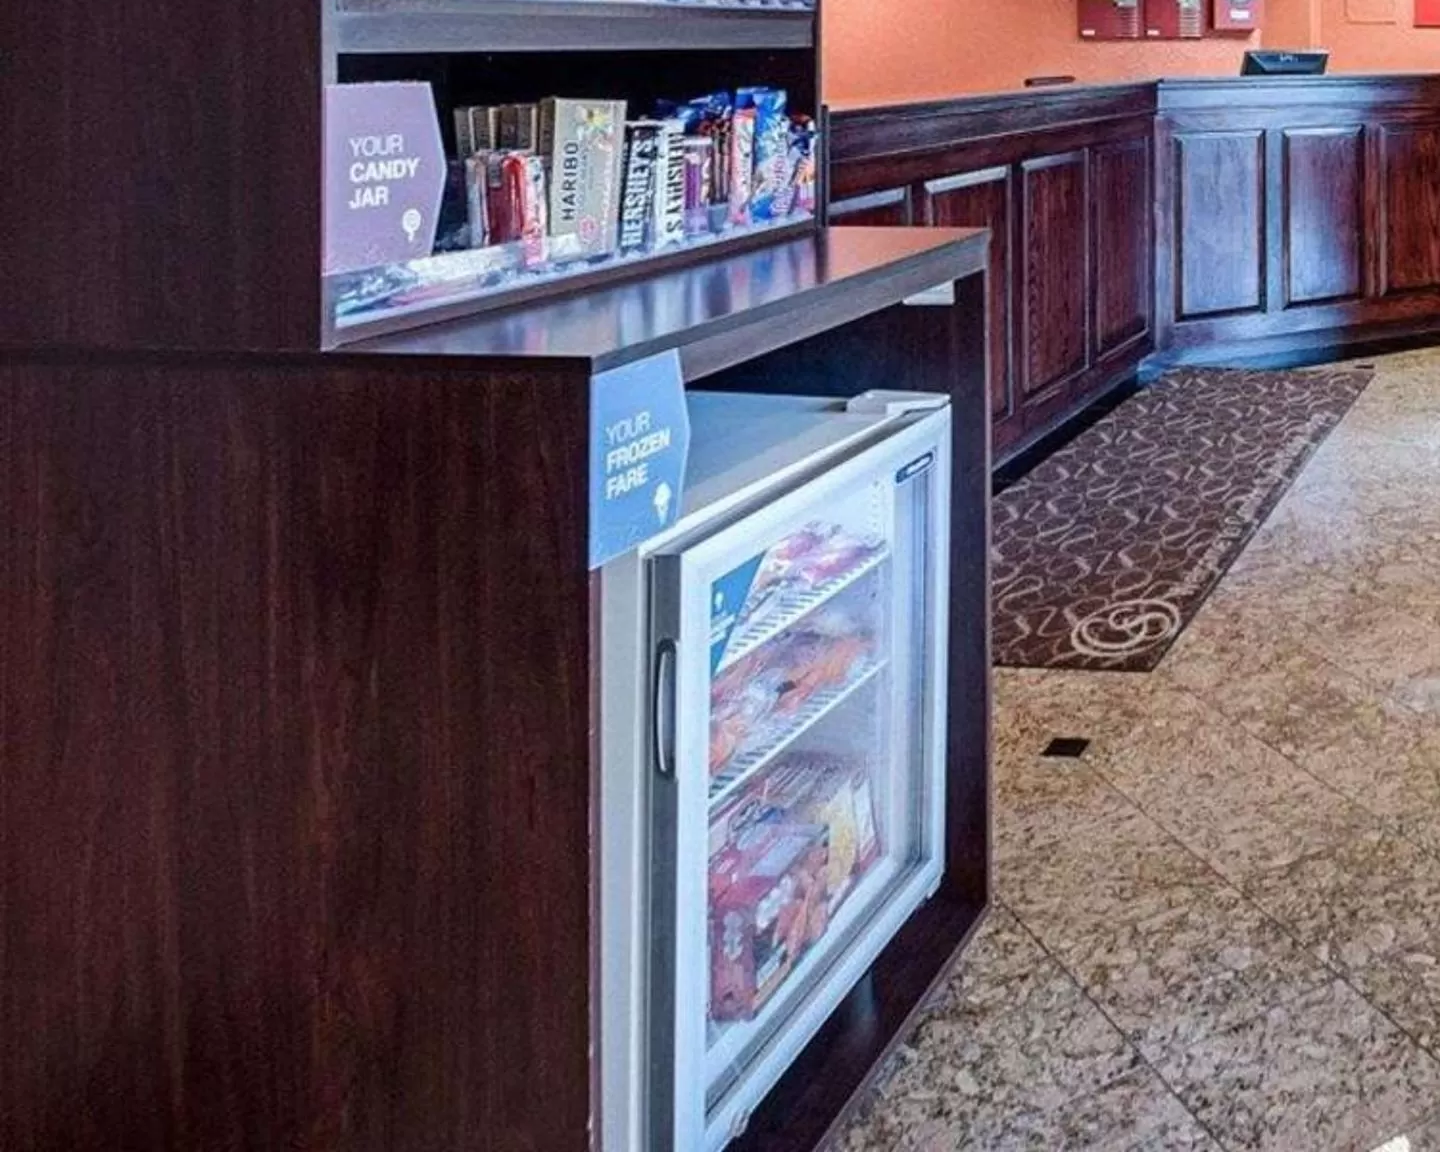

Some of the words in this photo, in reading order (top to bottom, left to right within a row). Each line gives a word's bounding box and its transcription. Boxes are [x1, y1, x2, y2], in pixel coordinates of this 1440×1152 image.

[350, 134, 404, 157] YOUR
[350, 157, 421, 183] CANDY
[561, 142, 579, 222] HARIBO
[349, 186, 388, 209] JAR
[605, 411, 650, 446] YOUR
[606, 427, 671, 475] FROZEN
[606, 462, 649, 500] FARE
